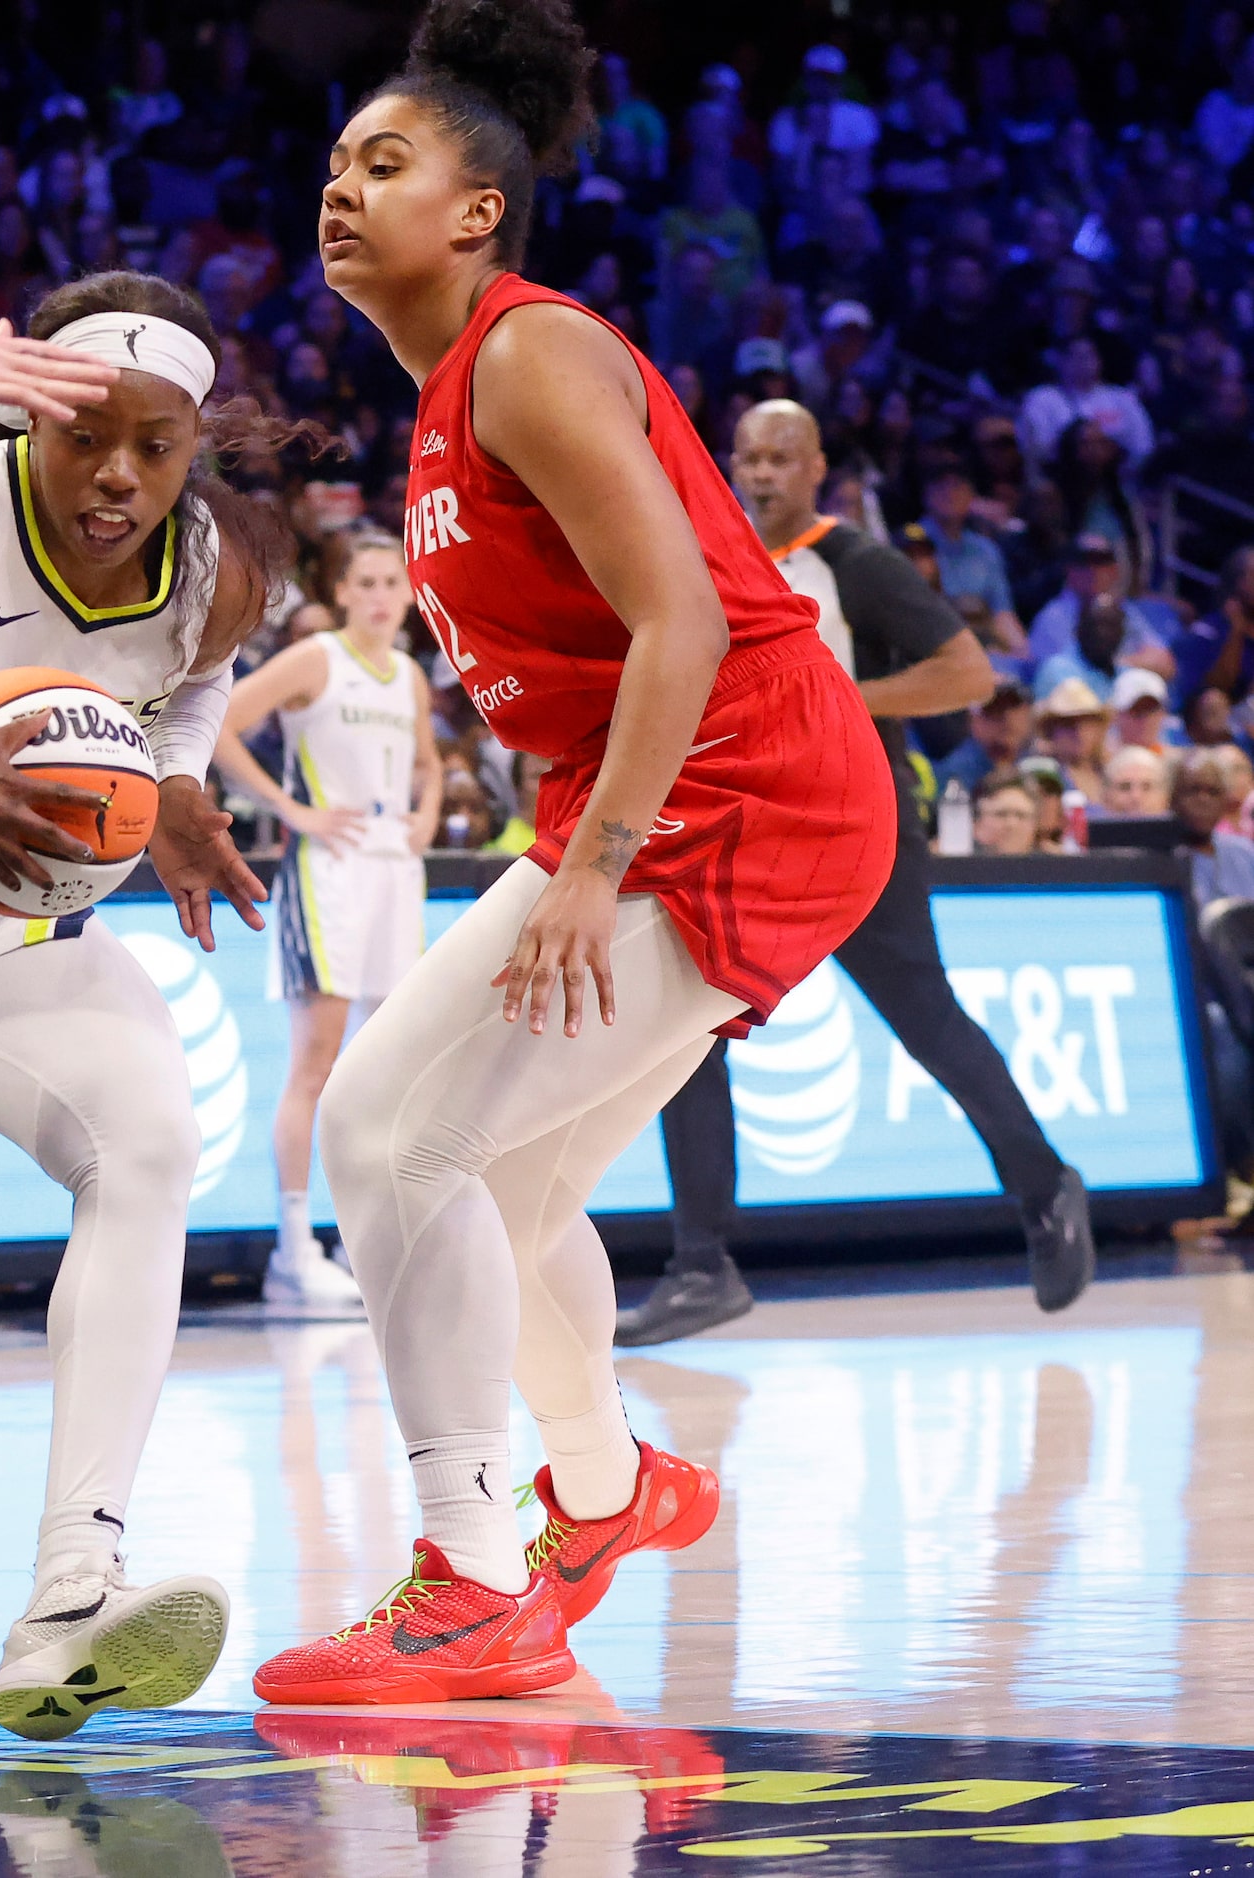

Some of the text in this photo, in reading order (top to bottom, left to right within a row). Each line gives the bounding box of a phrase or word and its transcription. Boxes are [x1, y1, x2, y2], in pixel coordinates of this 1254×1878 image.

[420, 428, 448, 459] Lilly
[415, 582, 478, 675] 12
[471, 675, 524, 725] force
[26, 705, 152, 761] Wilson
